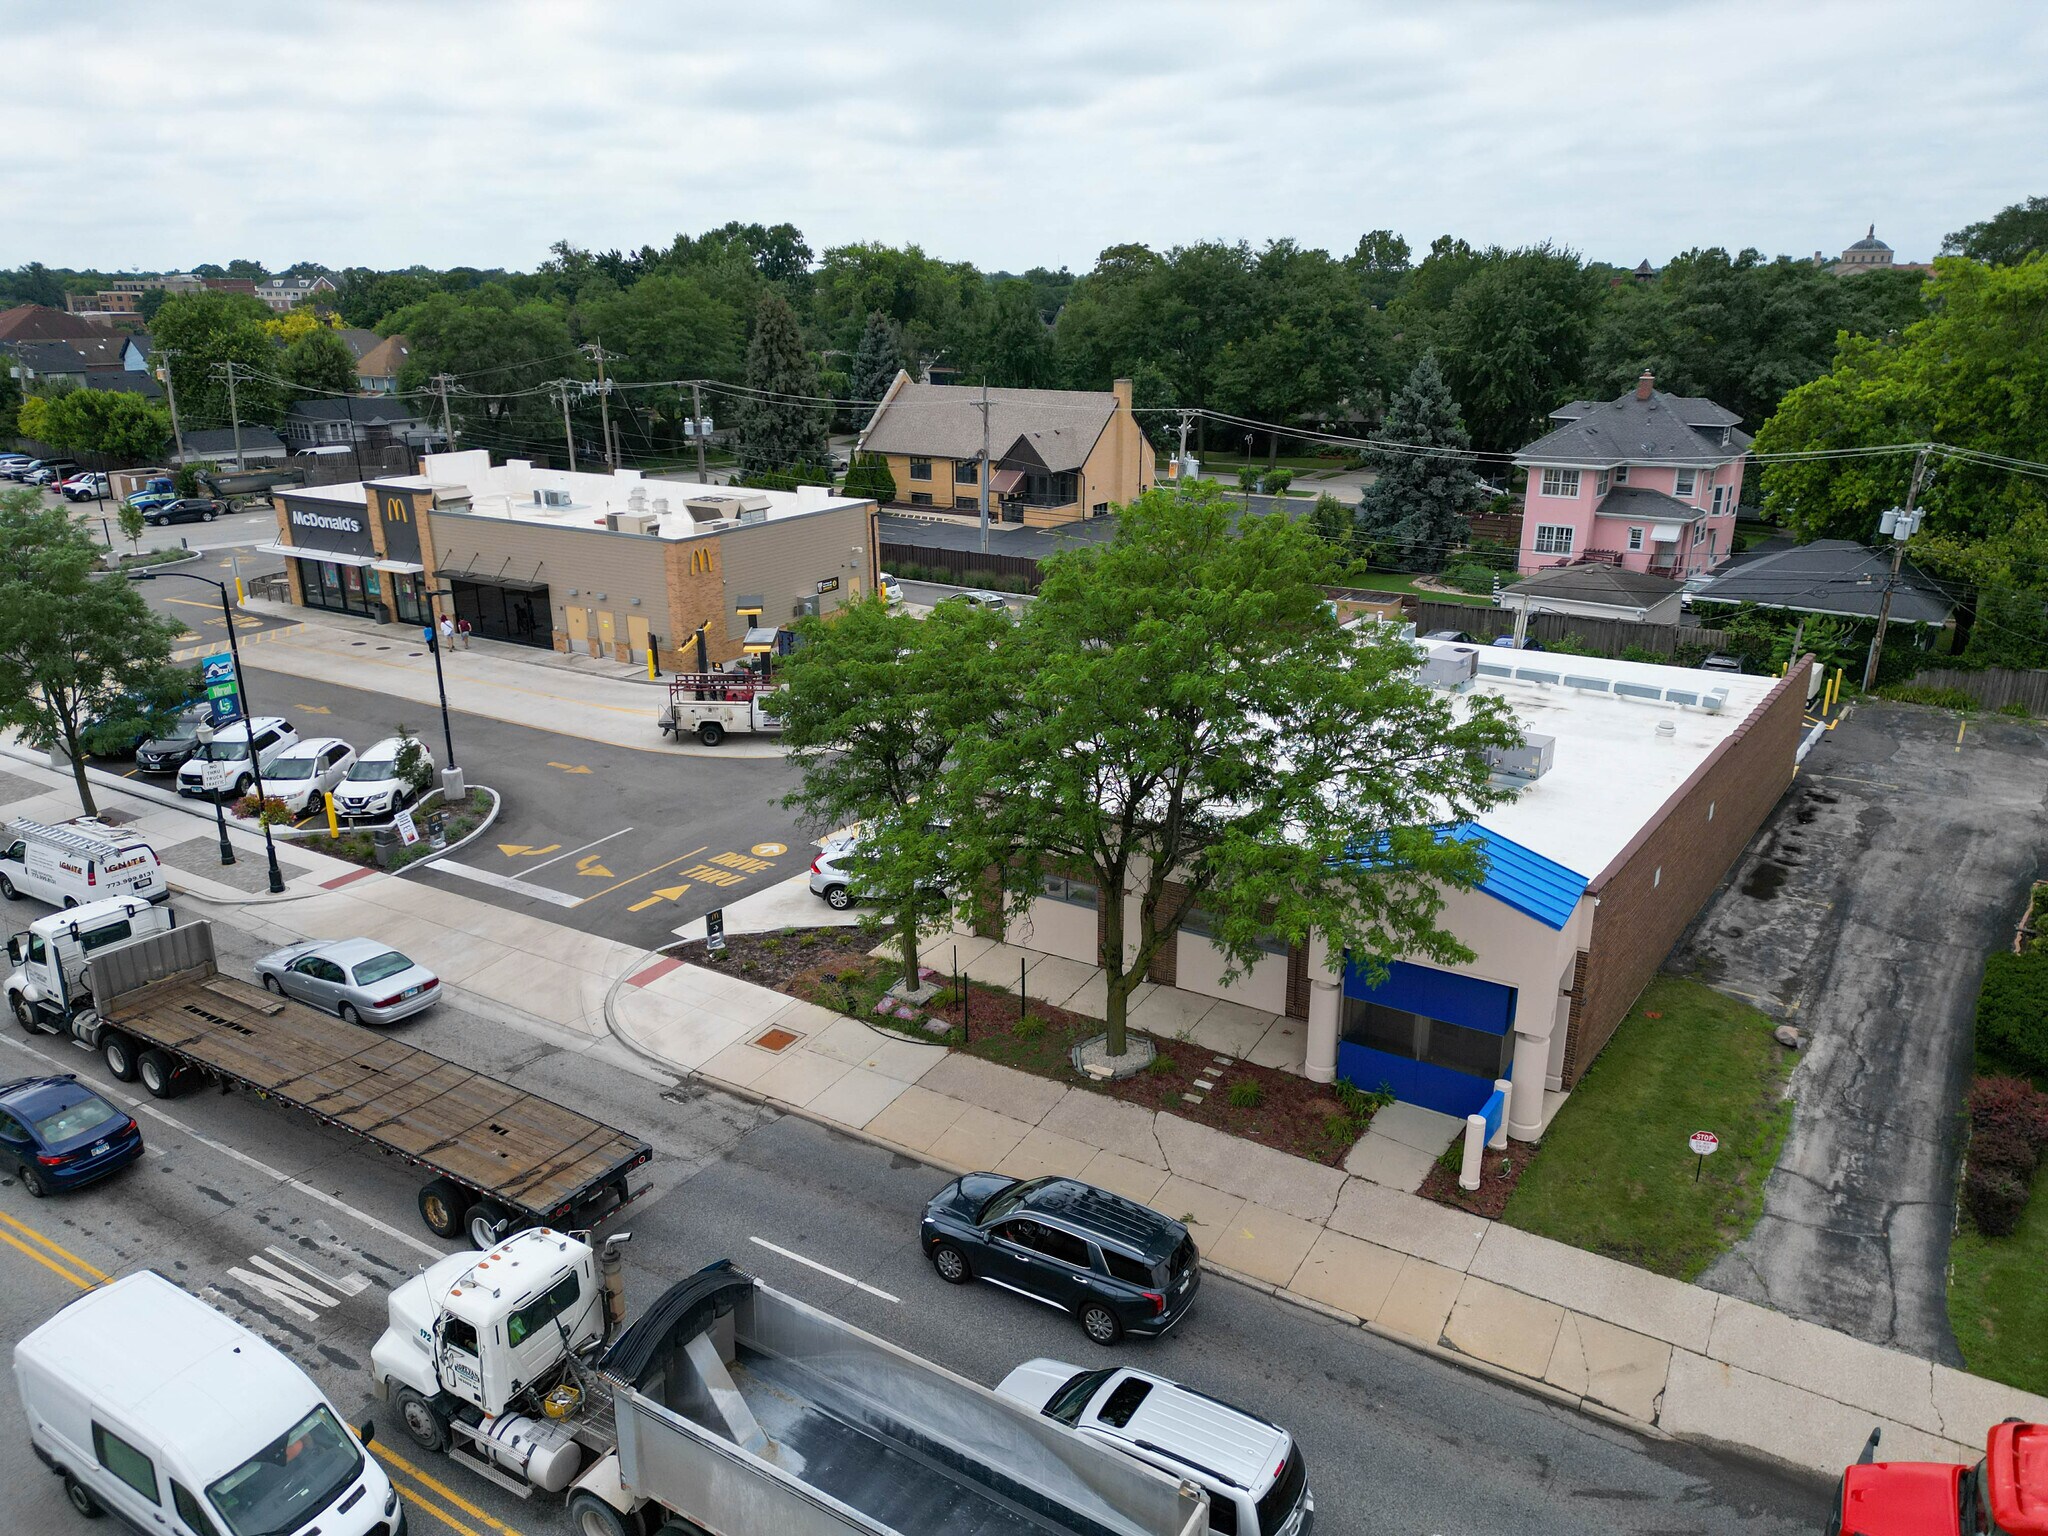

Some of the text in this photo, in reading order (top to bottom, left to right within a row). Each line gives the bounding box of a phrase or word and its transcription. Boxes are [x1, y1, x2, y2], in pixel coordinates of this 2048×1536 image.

[292, 510, 361, 533] McDonald's
[59, 861, 83, 875] IGNITE
[104, 856, 147, 873] IGNITE
[707, 851, 777, 874] DRIVE
[678, 864, 748, 887] THRU
[420, 1328, 432, 1343] 172
